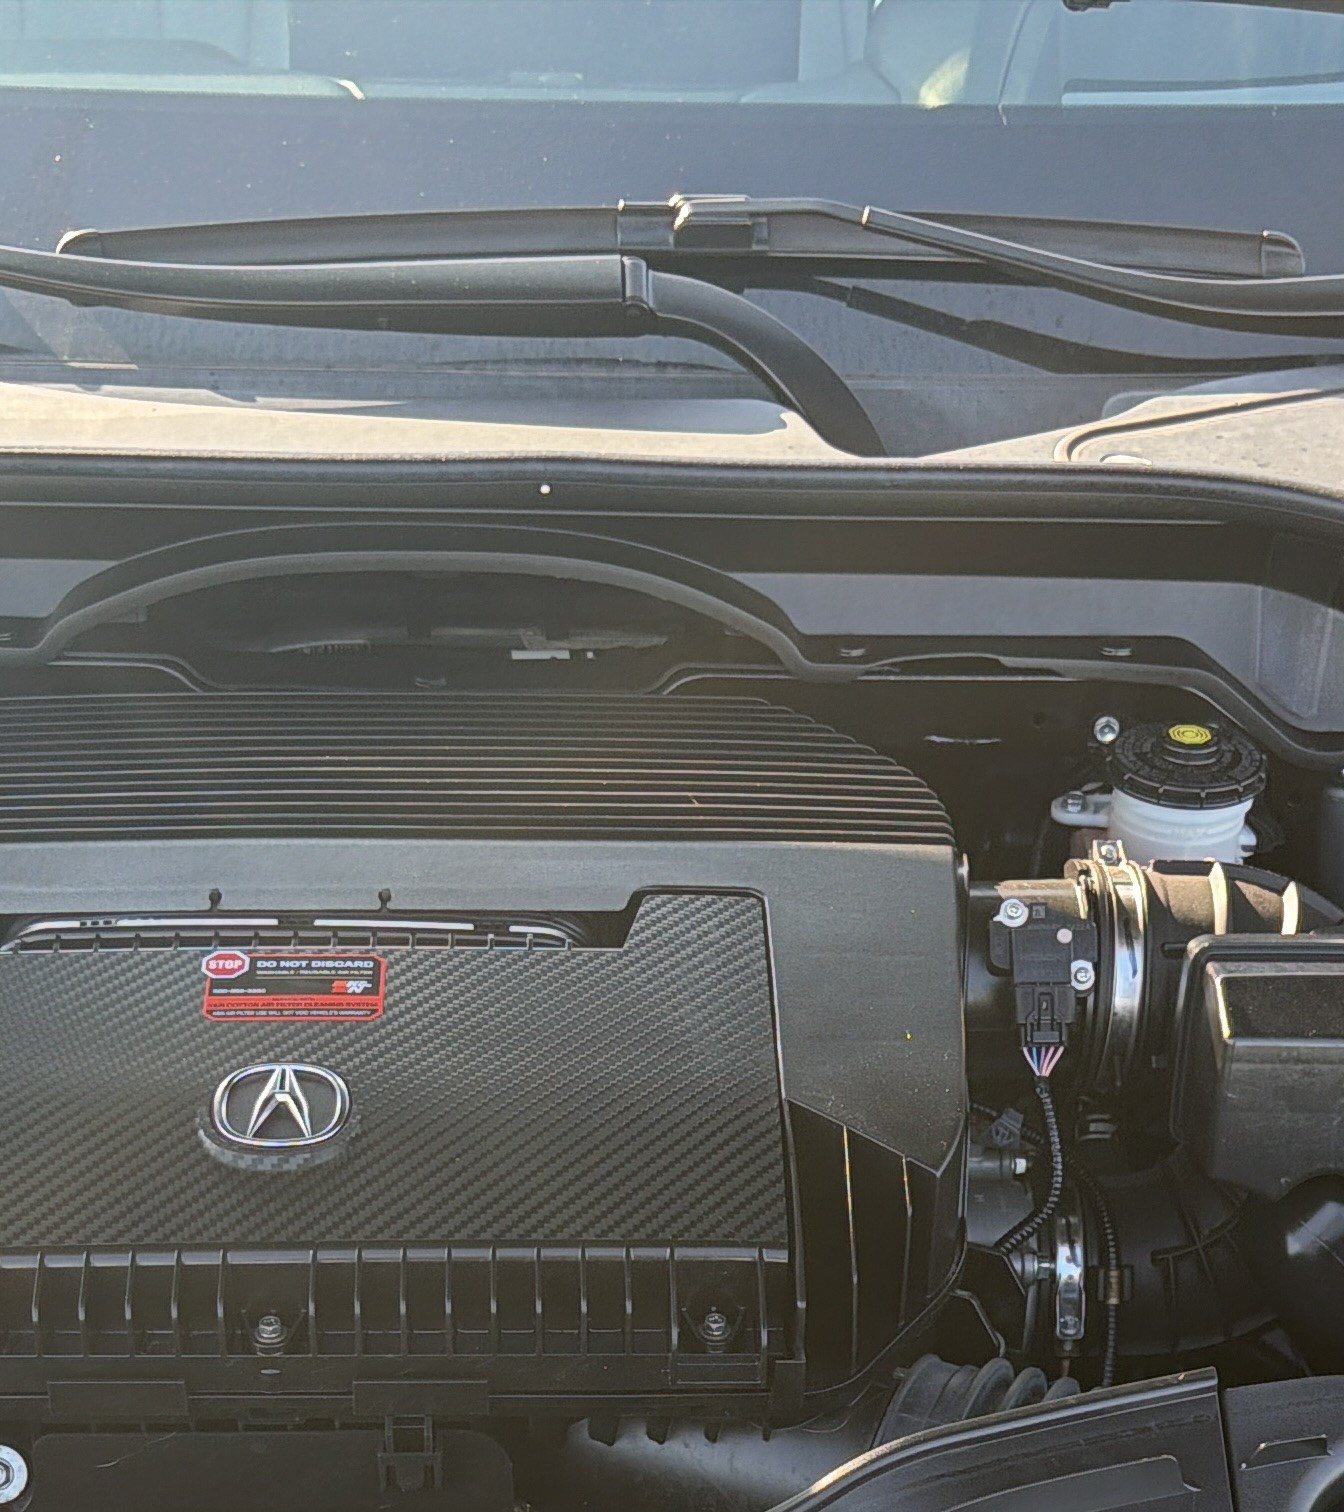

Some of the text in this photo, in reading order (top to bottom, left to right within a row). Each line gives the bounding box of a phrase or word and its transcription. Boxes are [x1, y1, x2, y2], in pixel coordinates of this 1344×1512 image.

[208, 959, 243, 970] STOP
[256, 960, 374, 968] DO NOT DISCARD
